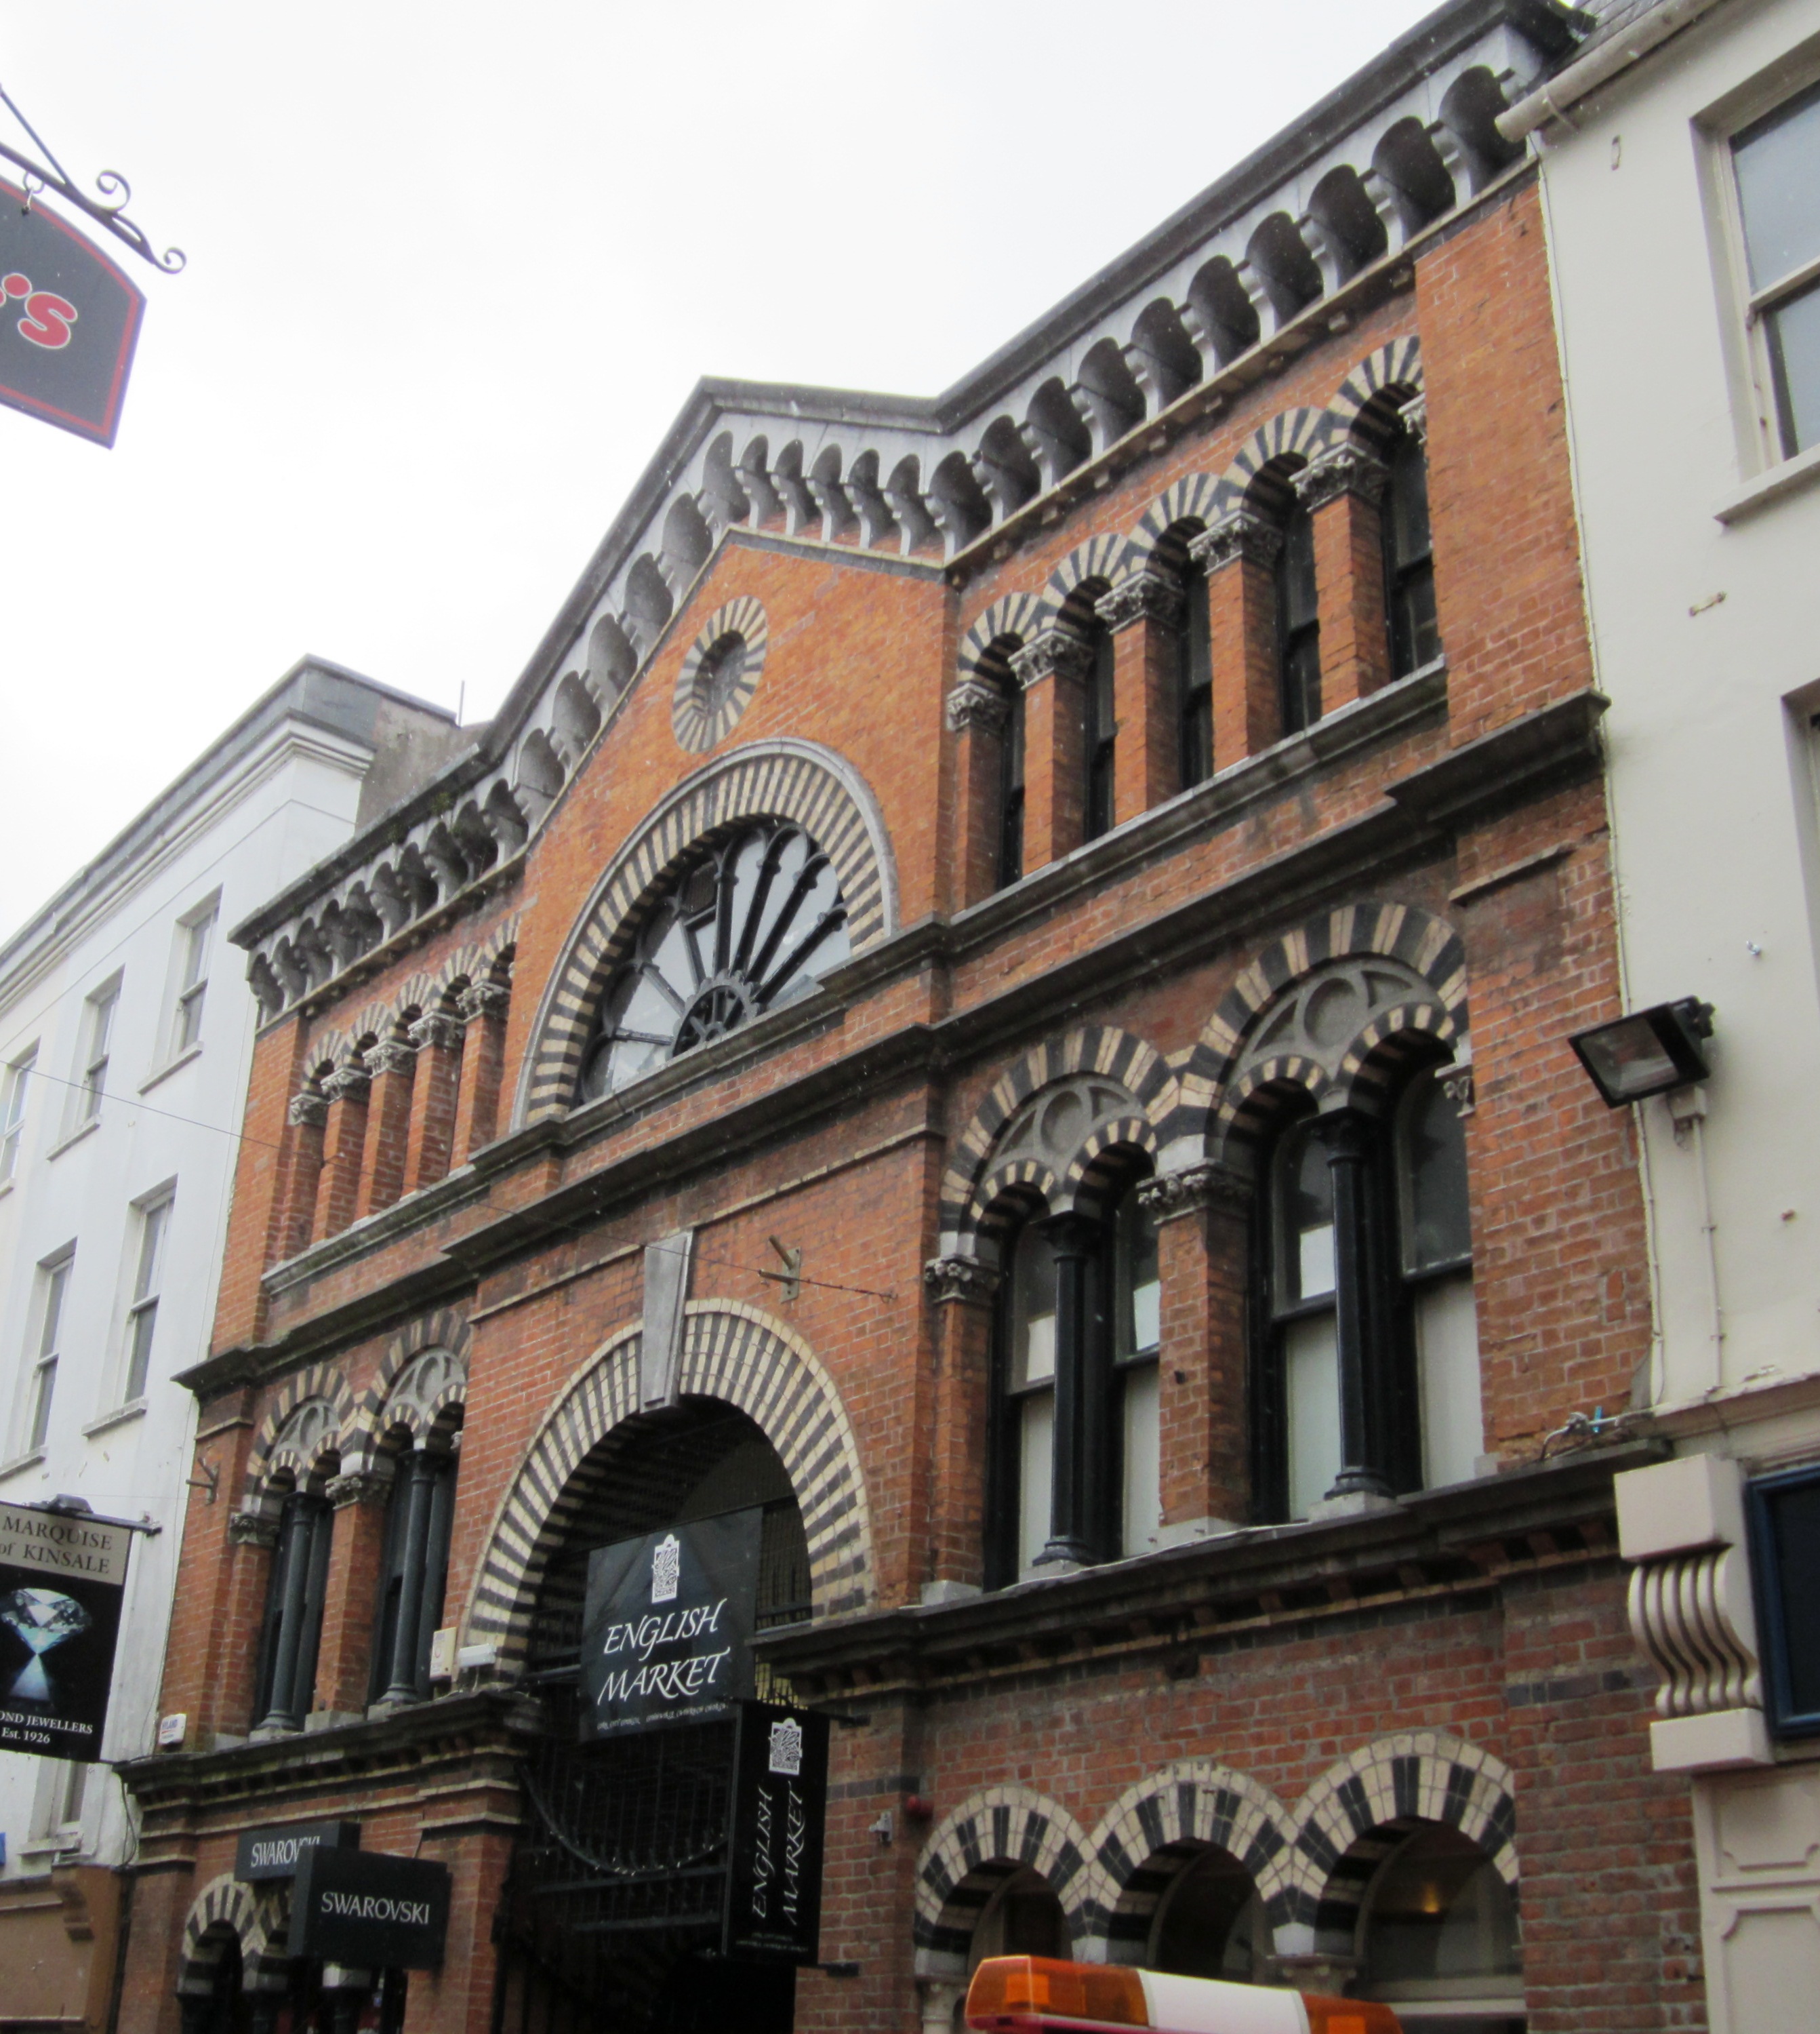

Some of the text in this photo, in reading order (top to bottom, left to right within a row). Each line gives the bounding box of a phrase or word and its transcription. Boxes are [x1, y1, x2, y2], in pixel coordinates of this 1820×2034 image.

[3, 1516, 113, 1551] MARQUISE
[23, 1544, 110, 1574] KINSALE
[603, 1598, 727, 1661] ENGLISH
[597, 1646, 731, 1706] MARKET
[1, 1727, 51, 1744] Est. 1926
[26, 1715, 93, 1734] JEWELLERS
[752, 1784, 775, 1918] ENGLISH
[783, 1780, 806, 1926] MARKET
[321, 1891, 430, 1926] SWAROVSKI
